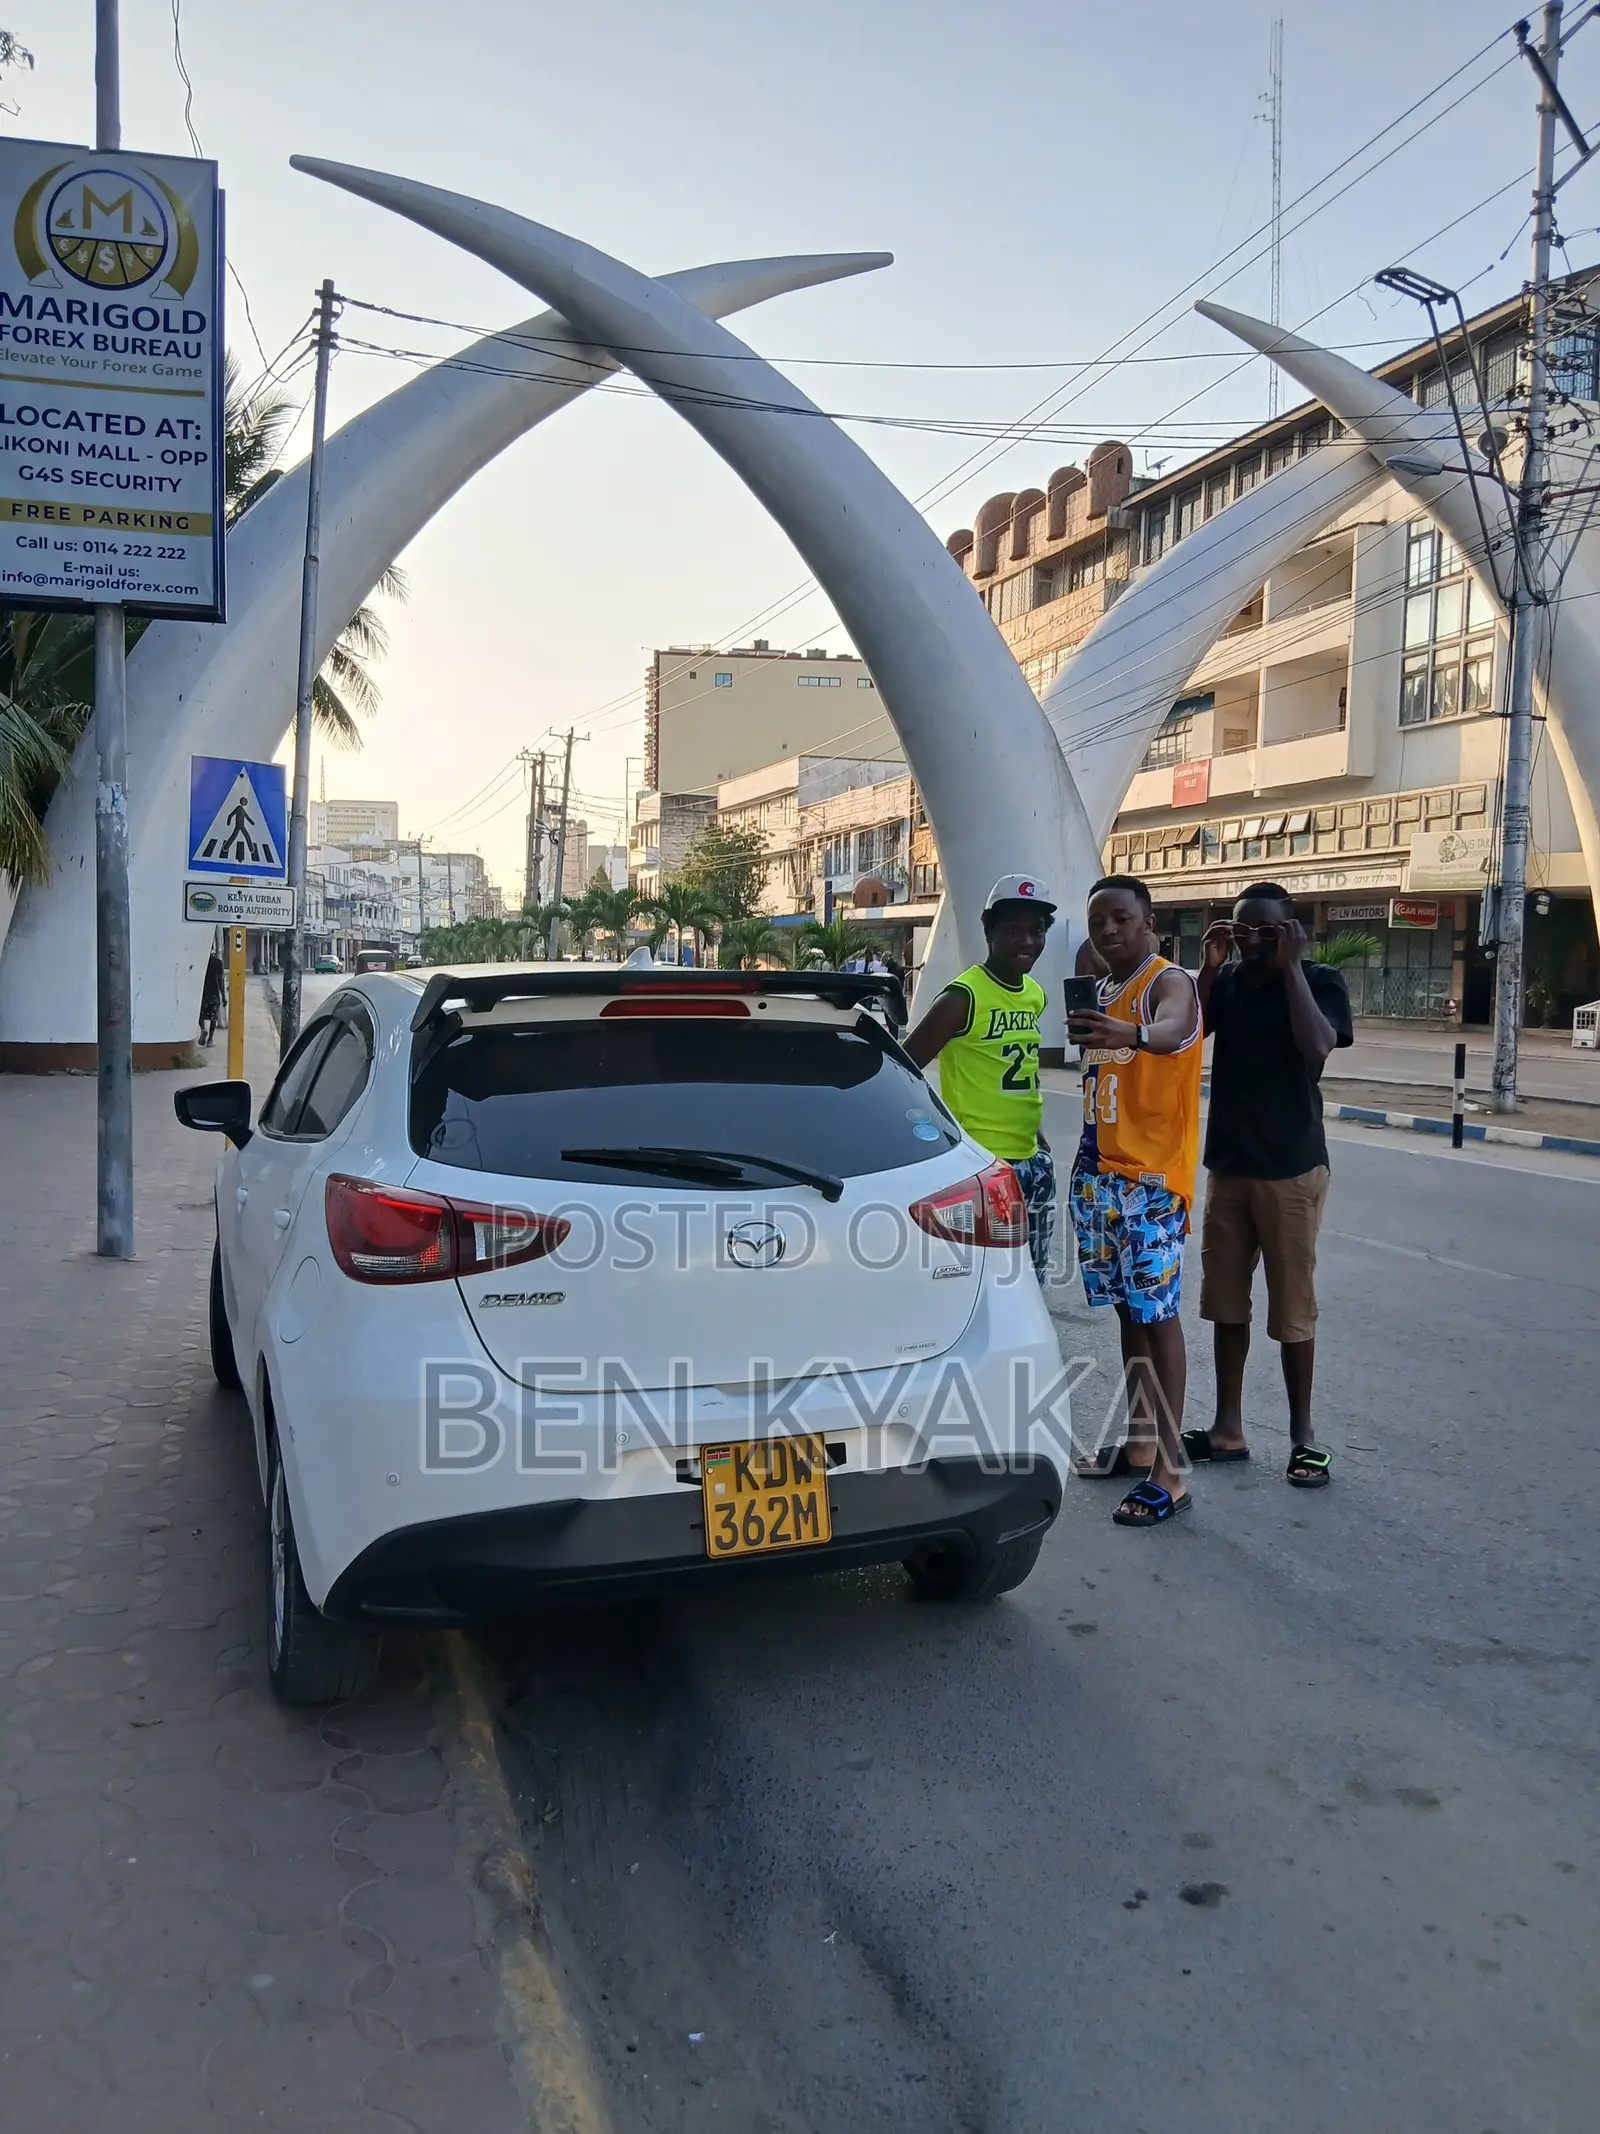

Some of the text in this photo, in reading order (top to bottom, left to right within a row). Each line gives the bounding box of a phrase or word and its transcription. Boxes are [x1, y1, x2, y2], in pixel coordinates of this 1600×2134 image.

[83, 184, 133, 234] M
[0, 292, 207, 334] MARIGOLD
[0, 323, 202, 359] FOREX BUREAU
[0, 348, 203, 378] Elevate Your Forex Game
[0, 403, 202, 441] LOCATED AT:
[78, 442, 140, 463] MALL
[161, 449, 208, 466] OPP
[18, 465, 183, 493] G4S SECURITY
[11, 503, 190, 530] FREE PARKING
[16, 535, 187, 560] Call us: 0114 222 222
[63, 561, 140, 577] E-mail us:
[1, 570, 199, 595] info@marigoldforex.com
[1316, 873, 1347, 889] LTD
[217, 904, 244, 914] ROADS
[246, 905, 291, 917] AUTHORITY
[227, 892, 282, 904] KENYA URBAN
[1339, 907, 1385, 918] LN MOTORS
[1400, 906, 1436, 916] CAR HIRE
[479, 1291, 566, 1308] DEMIO
[734, 1438, 814, 1492] KDW
[714, 1492, 820, 1550] 362M
